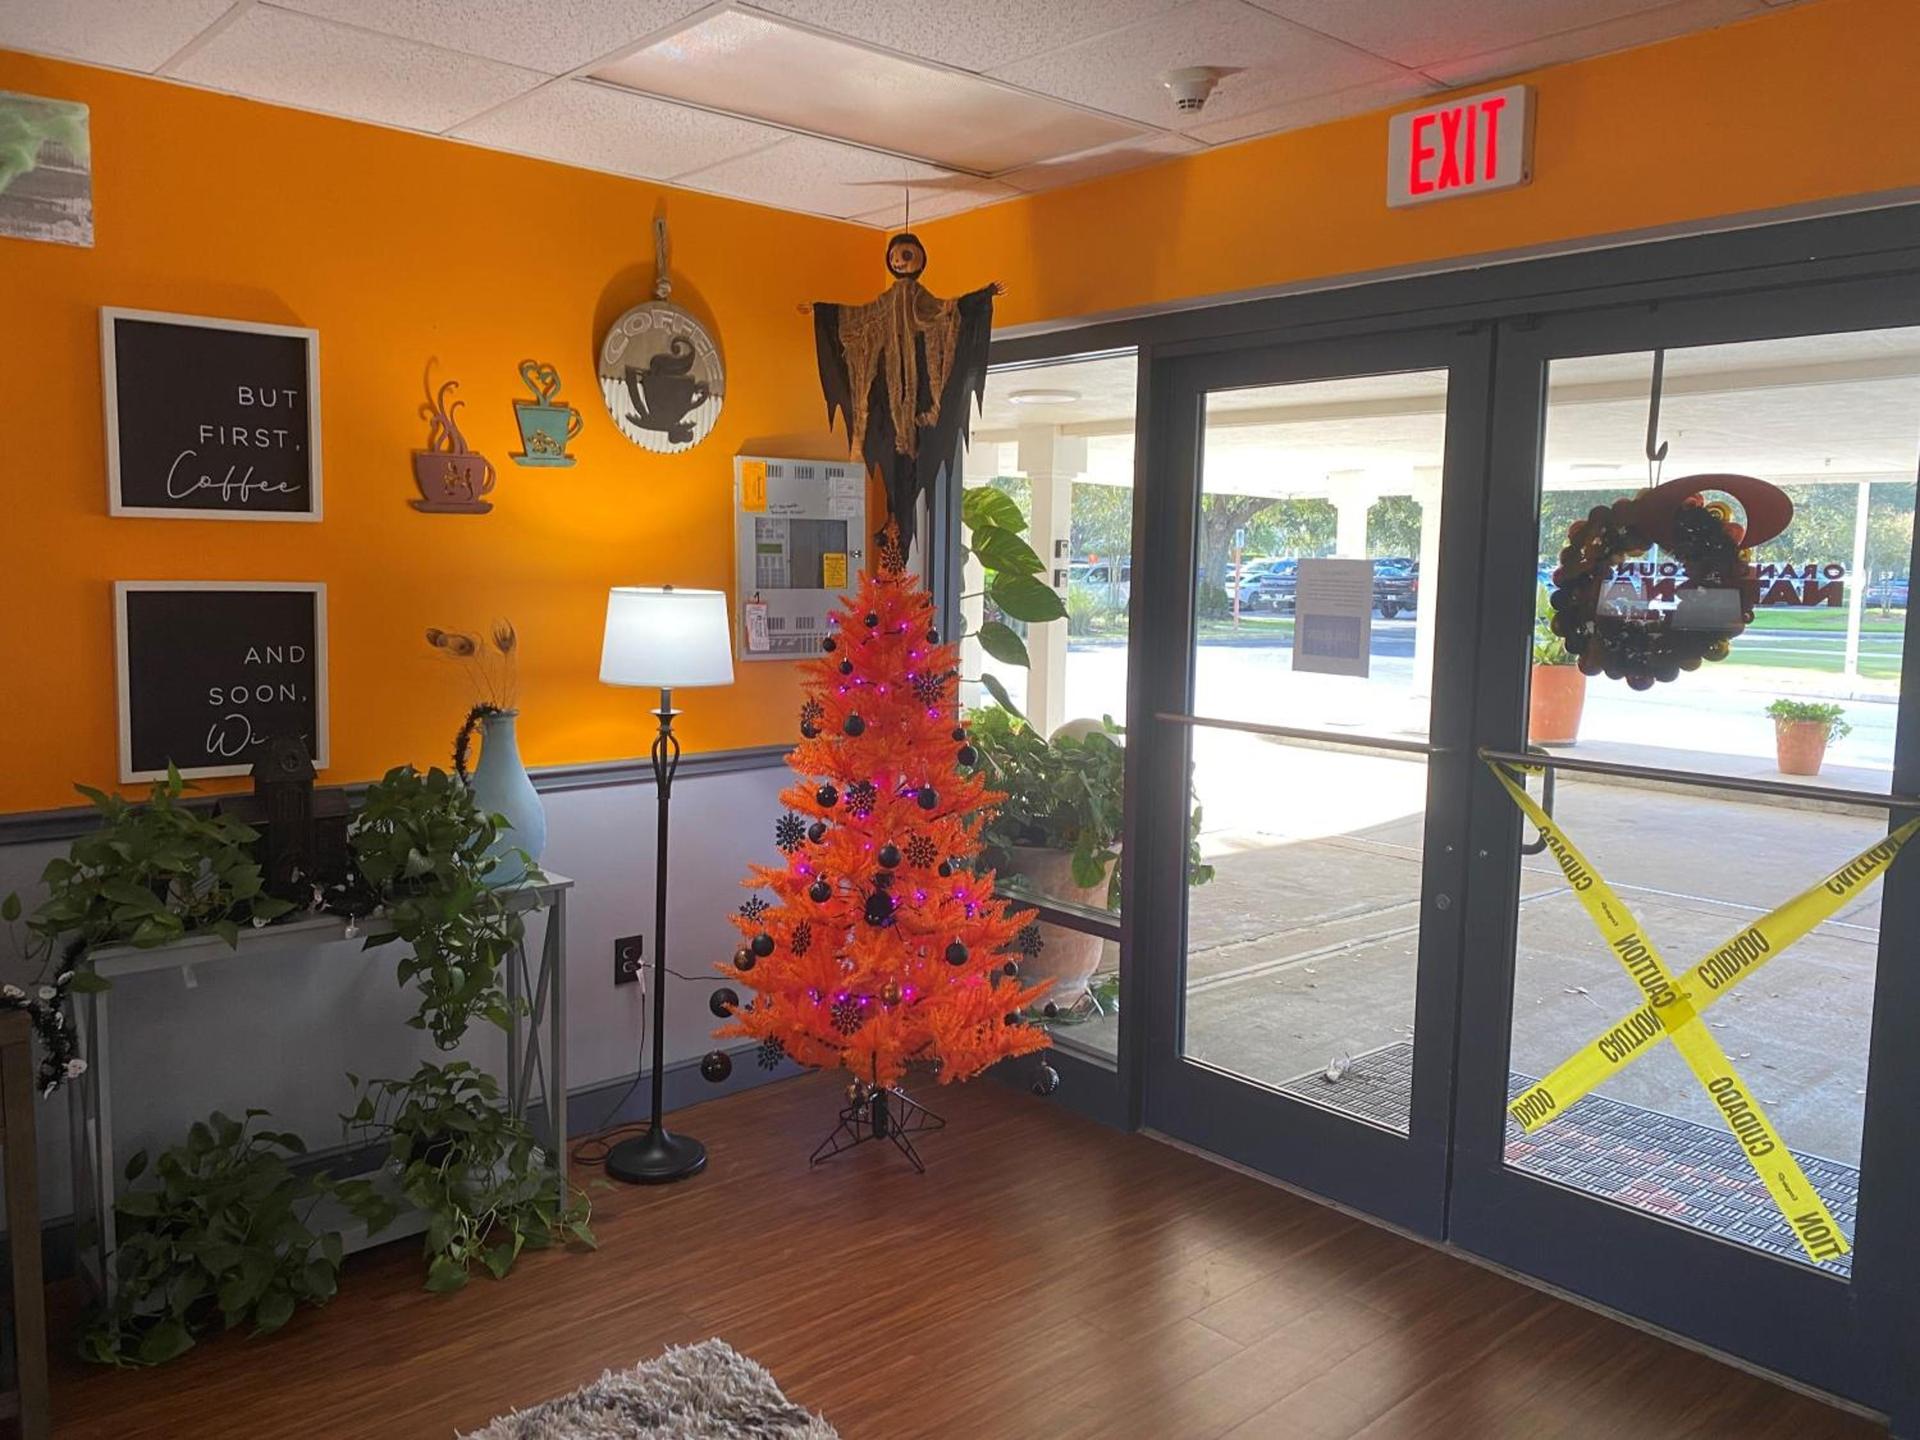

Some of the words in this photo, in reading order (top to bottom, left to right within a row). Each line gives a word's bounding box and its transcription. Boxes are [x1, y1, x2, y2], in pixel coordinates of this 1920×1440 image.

[1410, 97, 1506, 195] EXIT
[605, 309, 724, 393] COFFEE
[238, 386, 298, 408] BUT
[167, 450, 301, 502] Coffee
[243, 645, 305, 665] AND
[206, 713, 308, 757] Wi
